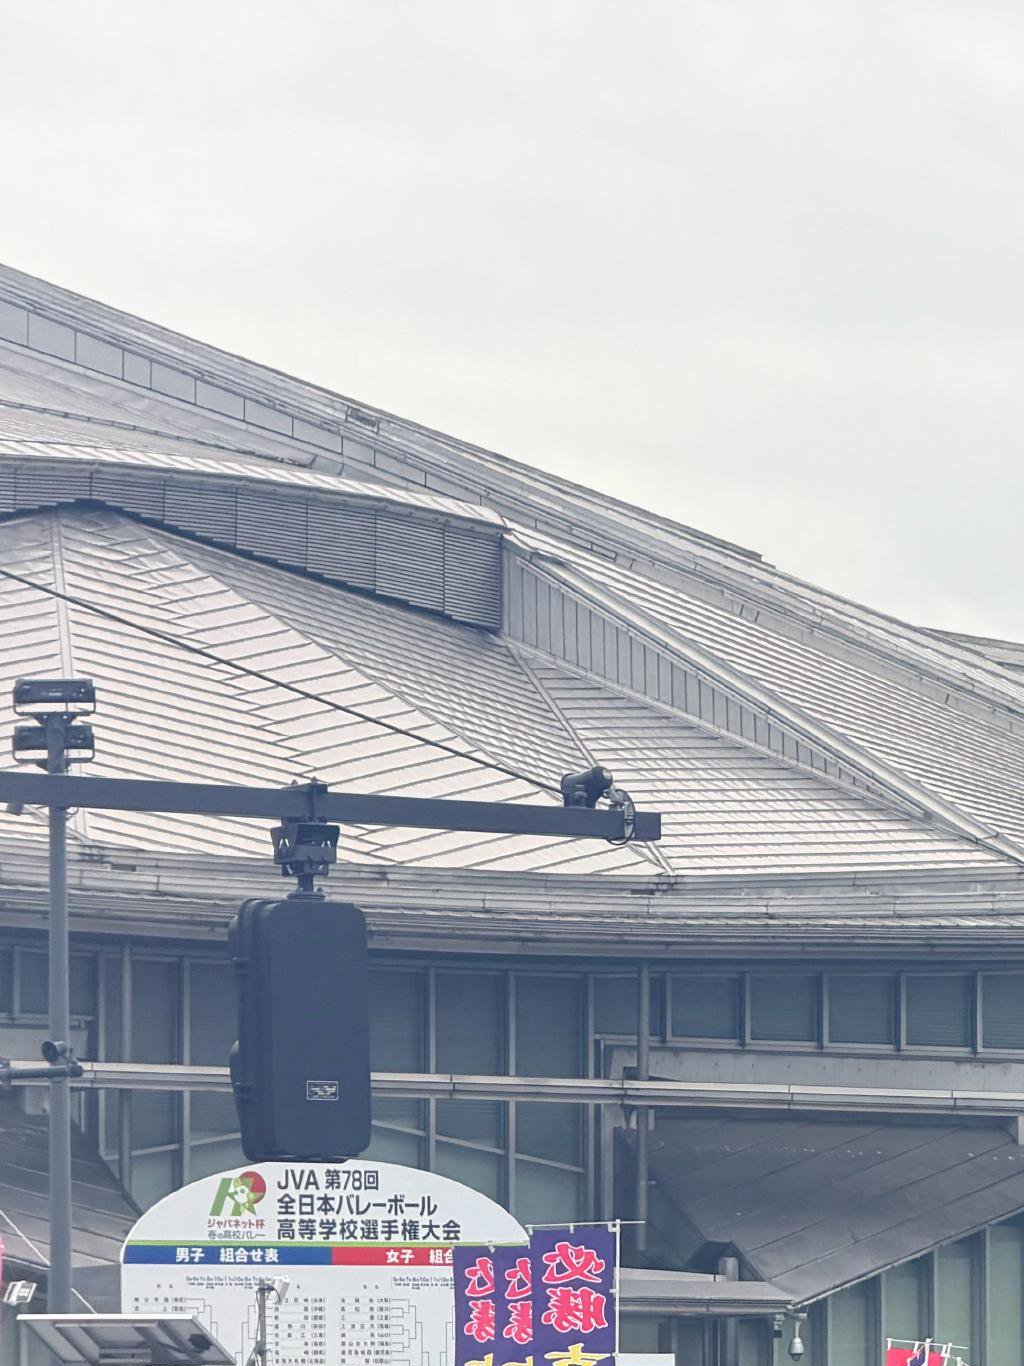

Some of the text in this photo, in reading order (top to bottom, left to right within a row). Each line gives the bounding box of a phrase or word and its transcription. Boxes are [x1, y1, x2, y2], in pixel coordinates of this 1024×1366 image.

[277, 1168, 379, 1191] JVA 第78回
[277, 1193, 438, 1217] 全日本バレーボール
[277, 1218, 461, 1241] 高等学校選手権大会
[175, 1247, 279, 1263] 男子 組合せ表
[385, 1249, 415, 1263] 女子
